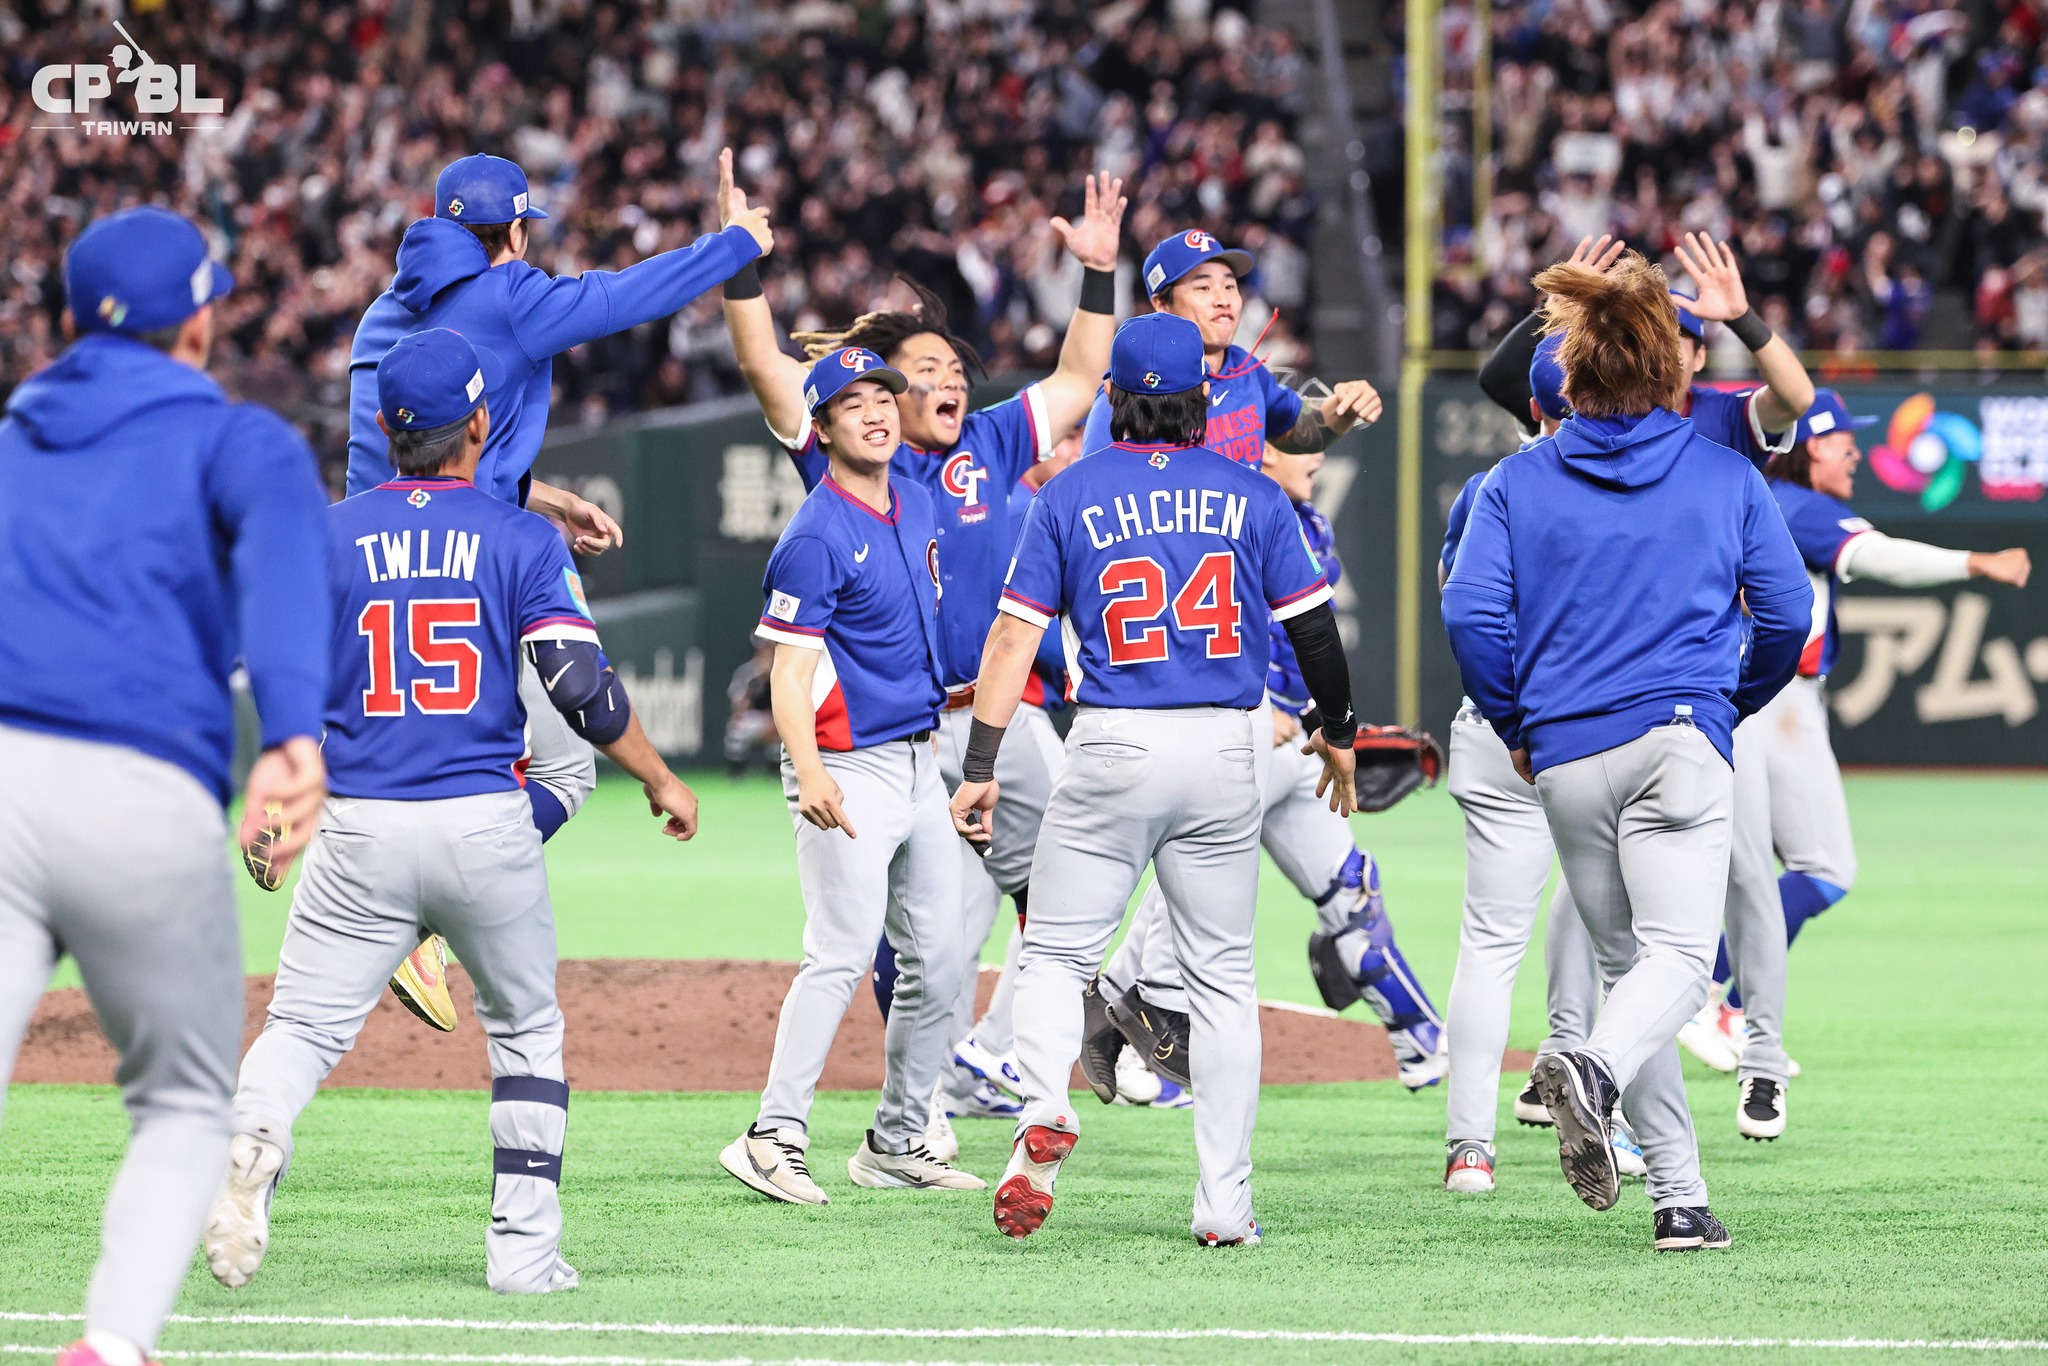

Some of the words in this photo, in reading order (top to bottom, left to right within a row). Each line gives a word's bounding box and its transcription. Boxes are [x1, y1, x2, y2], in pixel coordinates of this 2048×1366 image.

[1202, 403, 1263, 447] HINESE
[1081, 489, 1248, 550] C.H.CHEN
[355, 529, 480, 583] T.W.LIN
[1098, 551, 1242, 667] 24
[358, 598, 482, 717] 15
